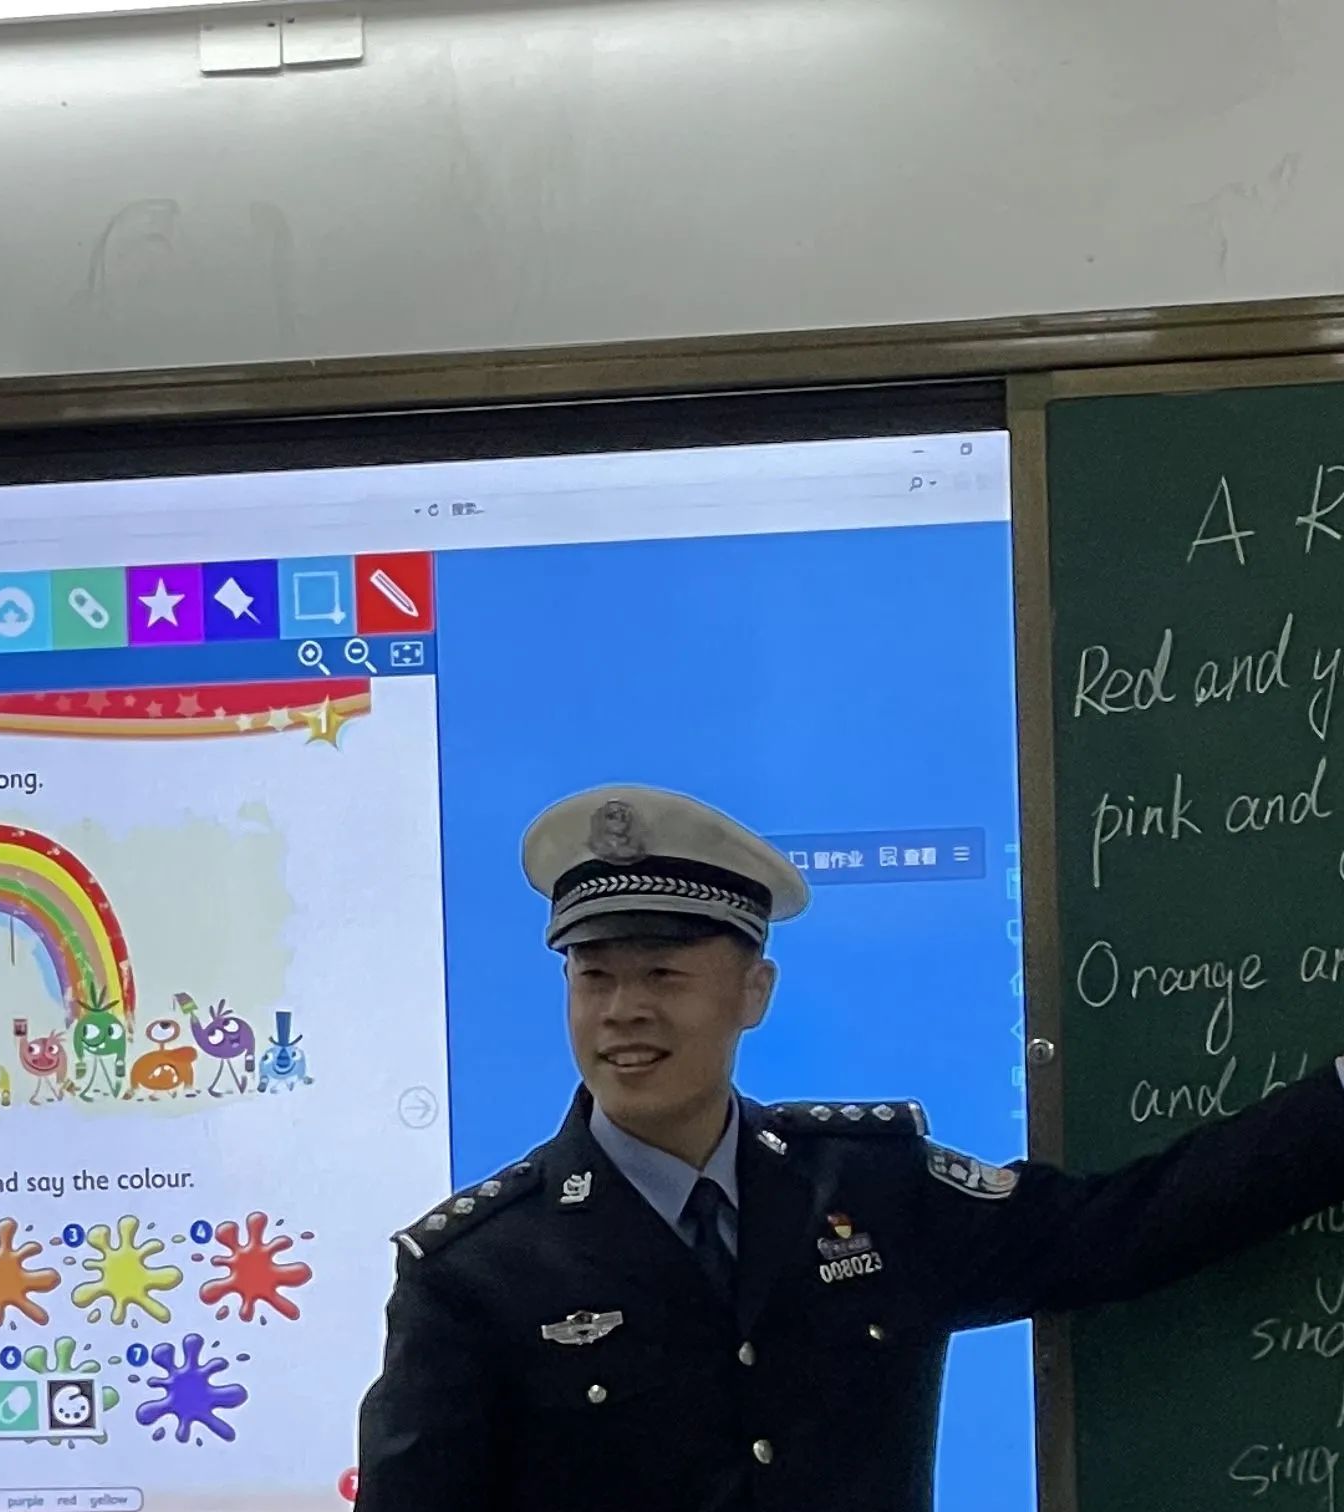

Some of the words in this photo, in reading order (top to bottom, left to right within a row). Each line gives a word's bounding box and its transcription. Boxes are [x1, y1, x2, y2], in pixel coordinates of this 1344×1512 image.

[1189, 475, 1255, 565] A
[1074, 629, 1174, 718] Red
[1192, 613, 1294, 698] and
[1092, 774, 1202, 887] pink
[1225, 752, 1326, 832] and
[1076, 940, 1268, 1055] Orange
[1131, 1056, 1240, 1121] and
[26, 1176, 65, 1199] say
[73, 1170, 109, 1193] the
[115, 1169, 195, 1192] colour.
[7, 1495, 44, 1510] purple
[57, 1494, 77, 1506] red
[89, 1493, 128, 1508] yellow
